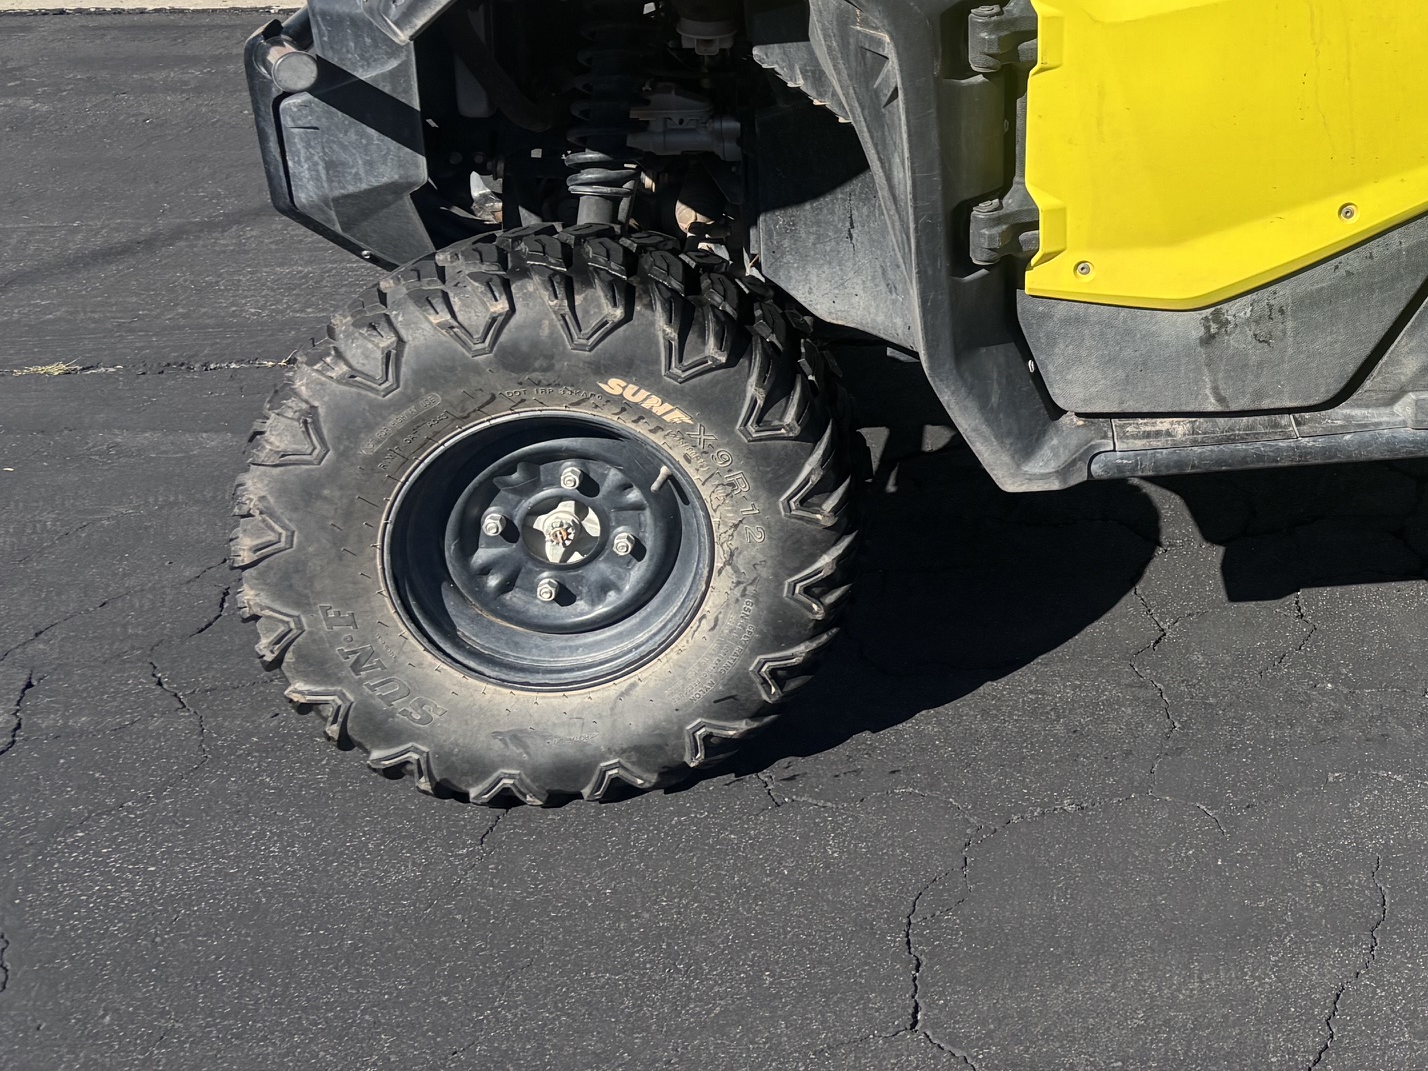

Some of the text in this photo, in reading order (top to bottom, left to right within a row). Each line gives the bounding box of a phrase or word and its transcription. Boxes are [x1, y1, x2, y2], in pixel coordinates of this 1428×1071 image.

[596, 377, 695, 424] SUNF
[719, 645, 743, 675] RATING
[688, 680, 715, 704] NYLON
